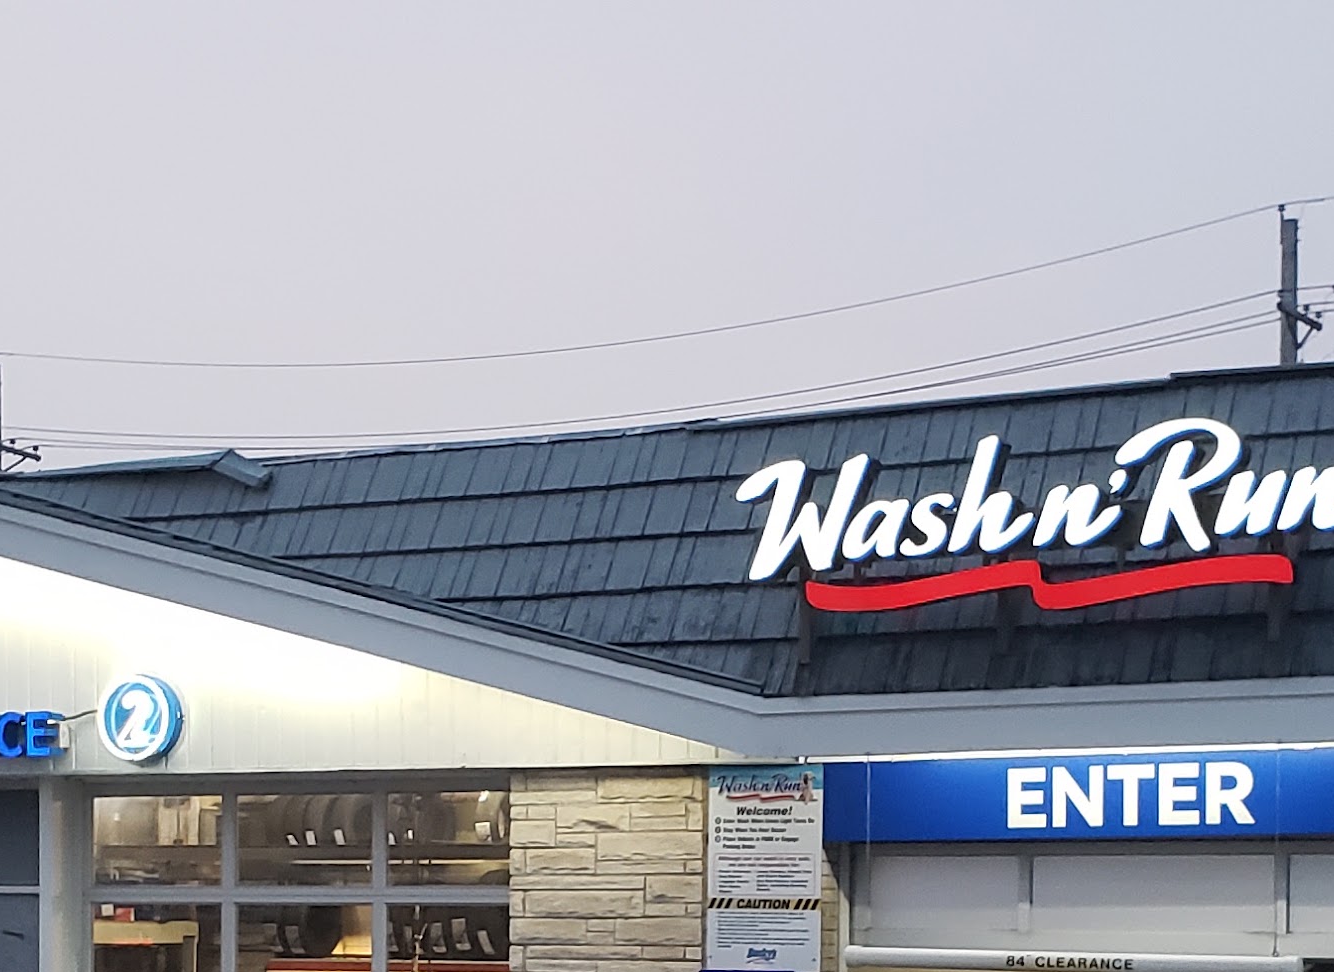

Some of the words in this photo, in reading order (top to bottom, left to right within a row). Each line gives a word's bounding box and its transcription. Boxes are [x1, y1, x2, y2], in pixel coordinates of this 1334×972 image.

[735, 434, 1036, 581] Wash
[771, 773, 801, 793] Run
[1006, 761, 1255, 829] ENTER
[736, 806, 793, 816] Welcome!
[736, 899, 791, 910] CAUTION
[1034, 956, 1135, 971] CLEARANCE
